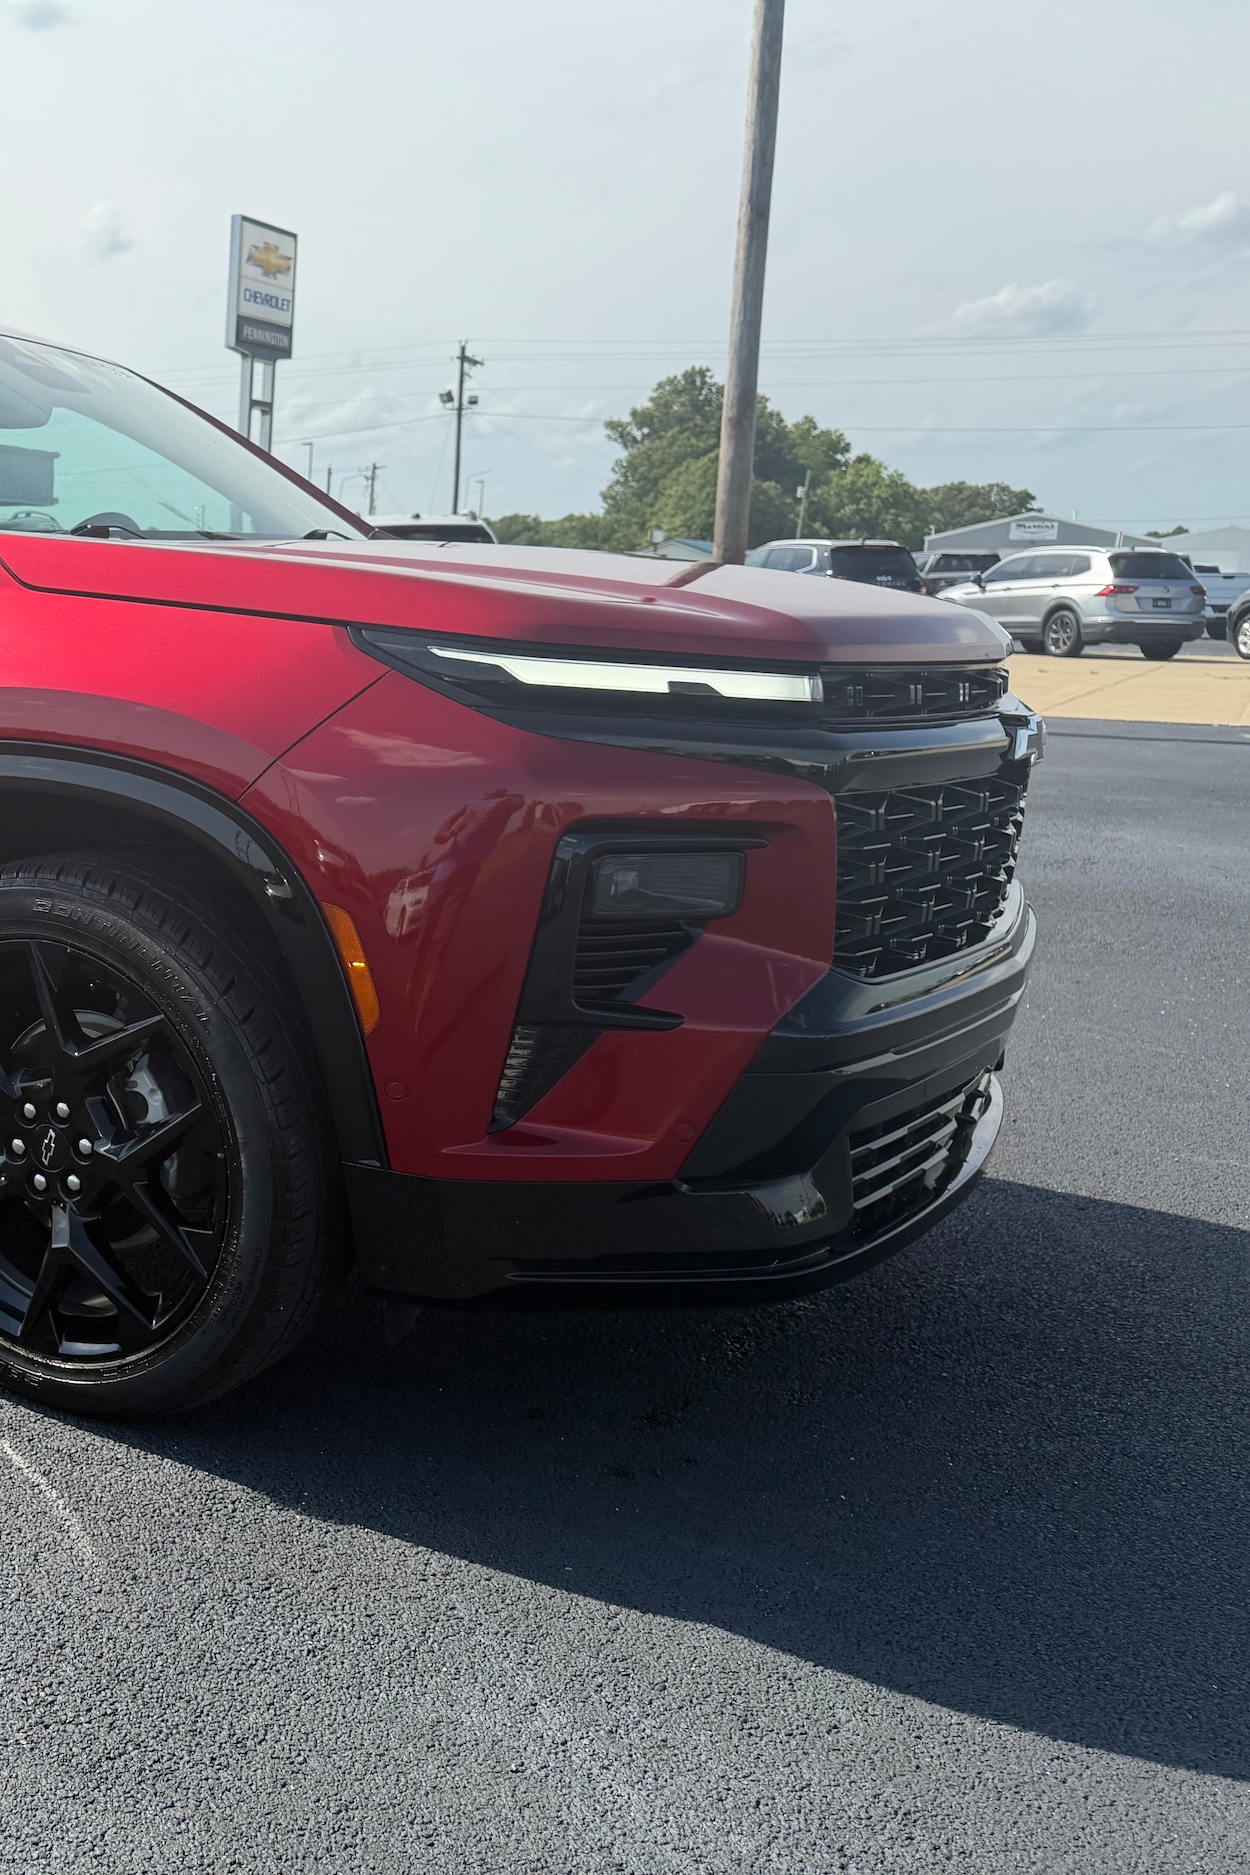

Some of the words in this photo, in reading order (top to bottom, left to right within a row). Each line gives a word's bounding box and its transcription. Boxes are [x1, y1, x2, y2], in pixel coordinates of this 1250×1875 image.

[243, 288, 291, 311] CHEVROLET
[242, 325, 288, 348] PENNINGTON
[32, 897, 210, 1021] CONTINENTAL
